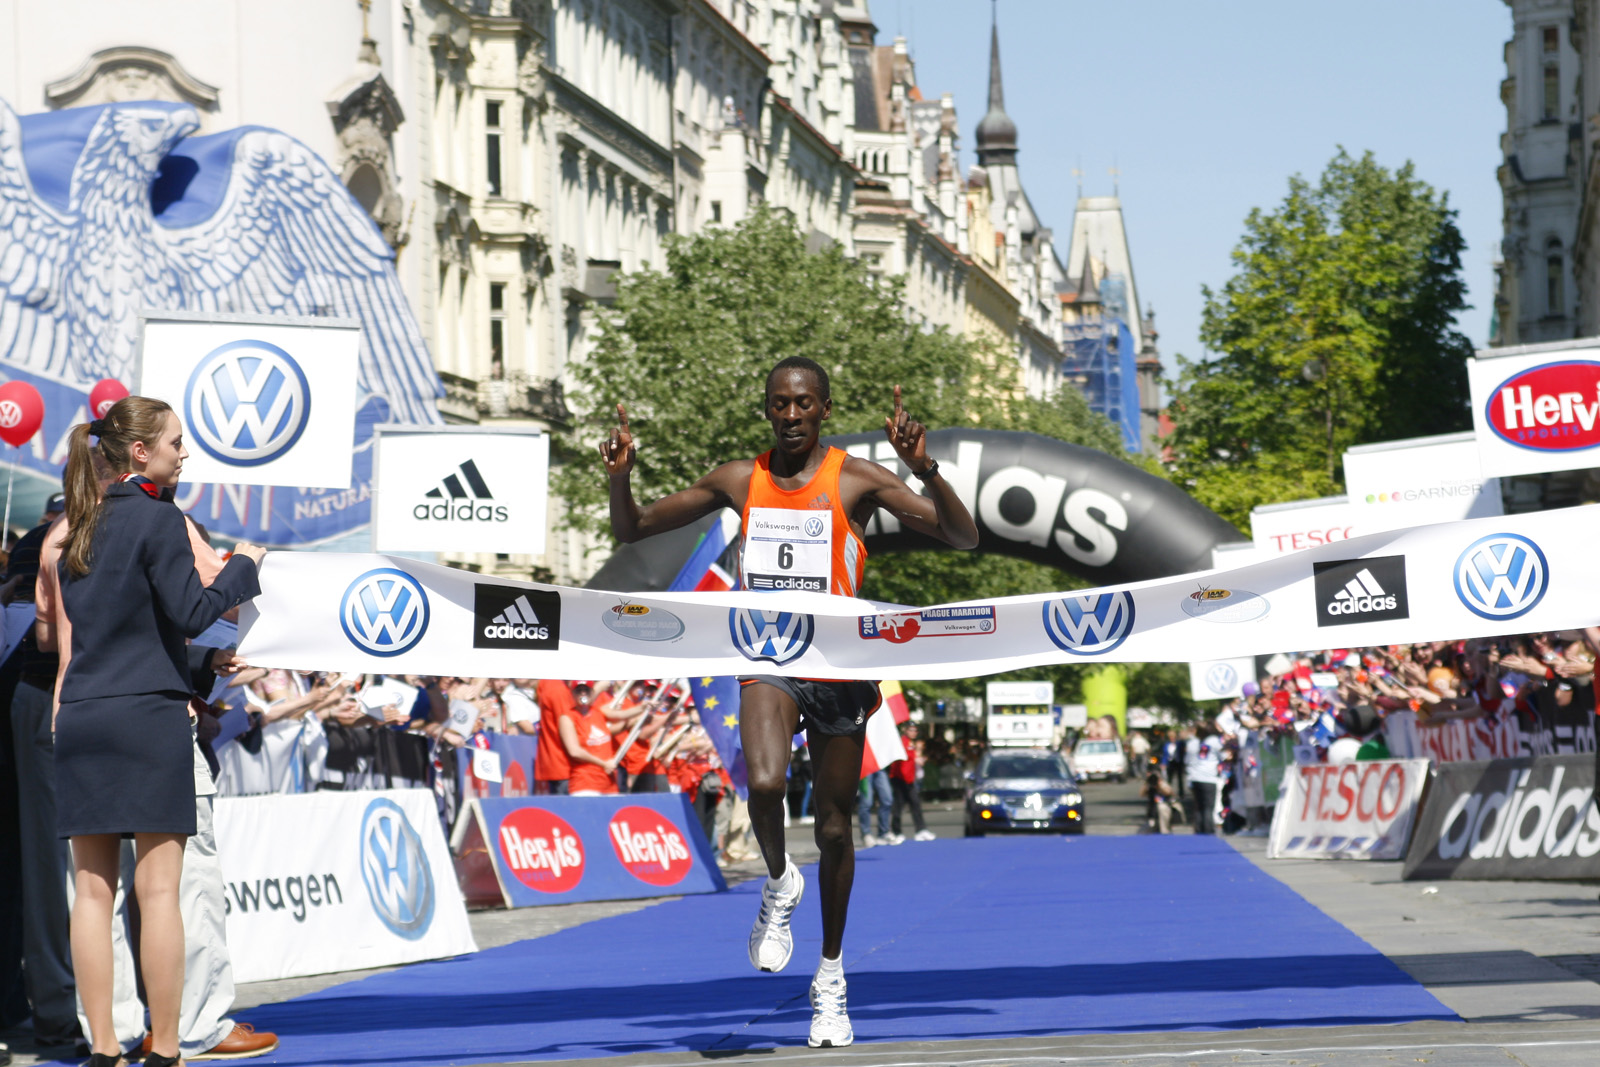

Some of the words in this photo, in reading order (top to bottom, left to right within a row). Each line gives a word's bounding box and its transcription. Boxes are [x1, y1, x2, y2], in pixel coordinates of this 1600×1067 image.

[1517, 425, 1580, 441] SPORTS
[413, 499, 509, 522] adidas
[755, 521, 800, 532] Volkswagen
[777, 543, 794, 570] 6
[774, 578, 820, 590] adidas
[922, 610, 950, 618] PRAGUE
[951, 607, 991, 617] MARATHON
[1327, 594, 1397, 615] adidas
[484, 622, 549, 640] adidas
[944, 624, 976, 632] Volkswagen
[1301, 763, 1405, 823] TESCO
[1438, 766, 1600, 859] adidas
[501, 826, 582, 877] Hervis
[610, 821, 689, 871] Hervis
